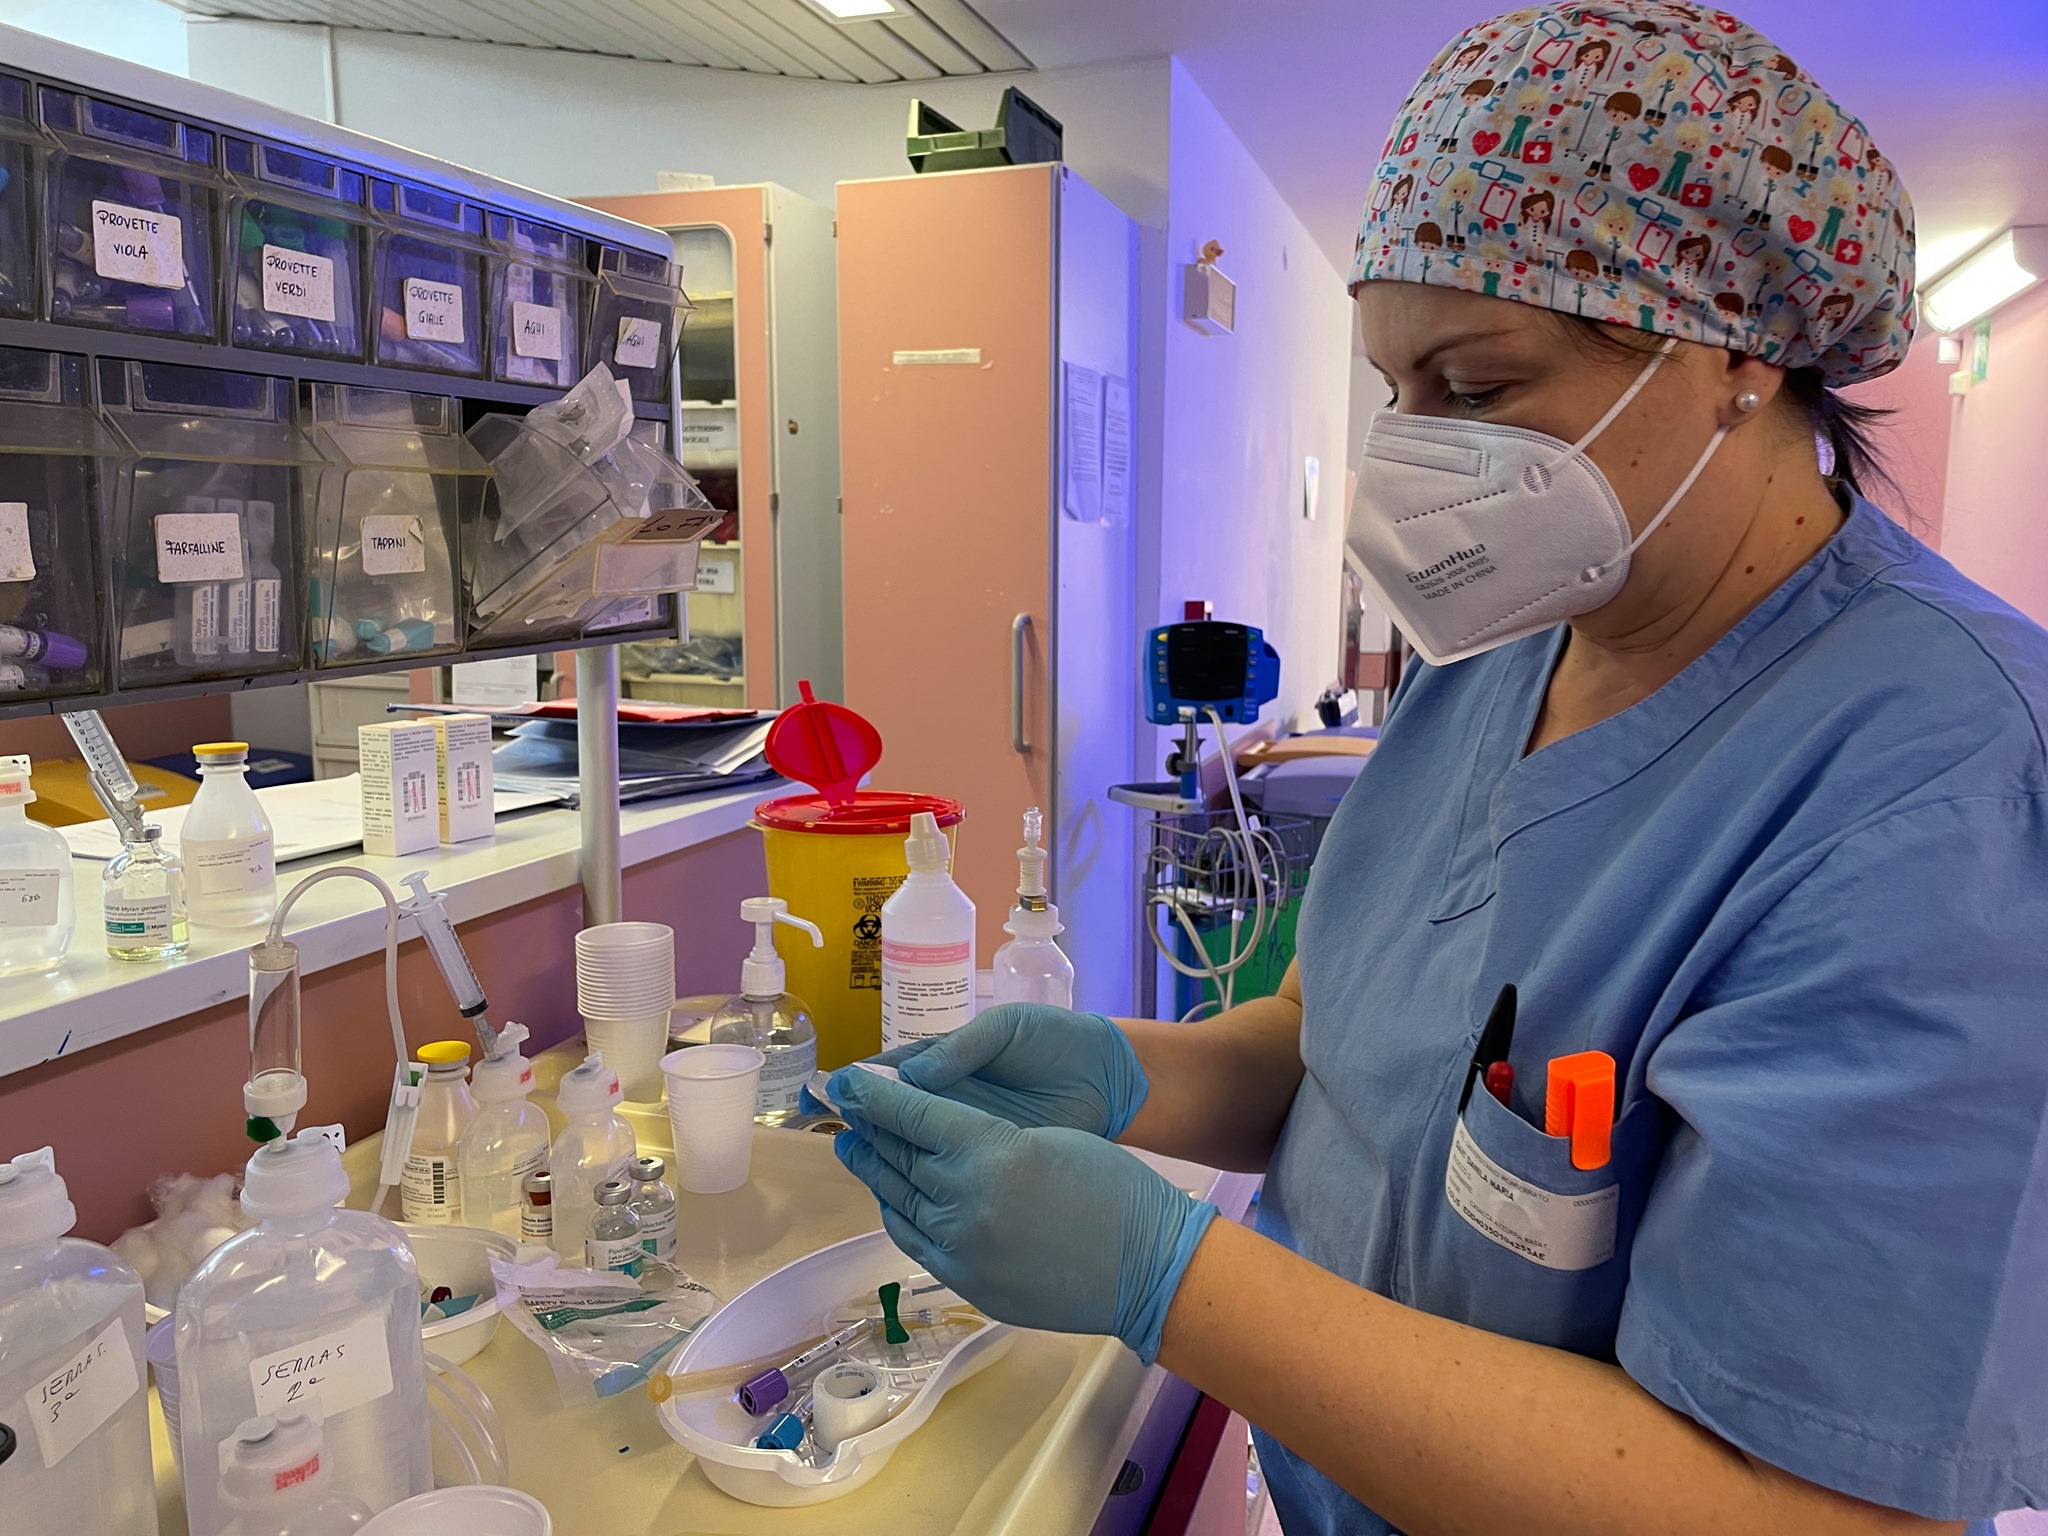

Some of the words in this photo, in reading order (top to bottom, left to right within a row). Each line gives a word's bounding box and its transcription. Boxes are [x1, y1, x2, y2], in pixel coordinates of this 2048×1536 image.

[97, 210, 159, 233] PROVETTE
[114, 244, 148, 260] VIOLA
[266, 255, 318, 278] PROVETTE
[275, 281, 306, 298] VERDI
[409, 285, 453, 305] PROVETTE
[418, 315, 444, 326] GIALLE
[524, 321, 545, 336] AGHI
[165, 540, 226, 556] FARFALLINE
[371, 537, 406, 550] TAPPINI
[1405, 543, 1487, 584] GuanHua
[1422, 586, 1453, 600] MADE
[1451, 580, 1465, 591] IN
[1464, 565, 1498, 584] CHINA
[121, 905, 140, 913] Mylan
[261, 1344, 345, 1386] SERRAS
